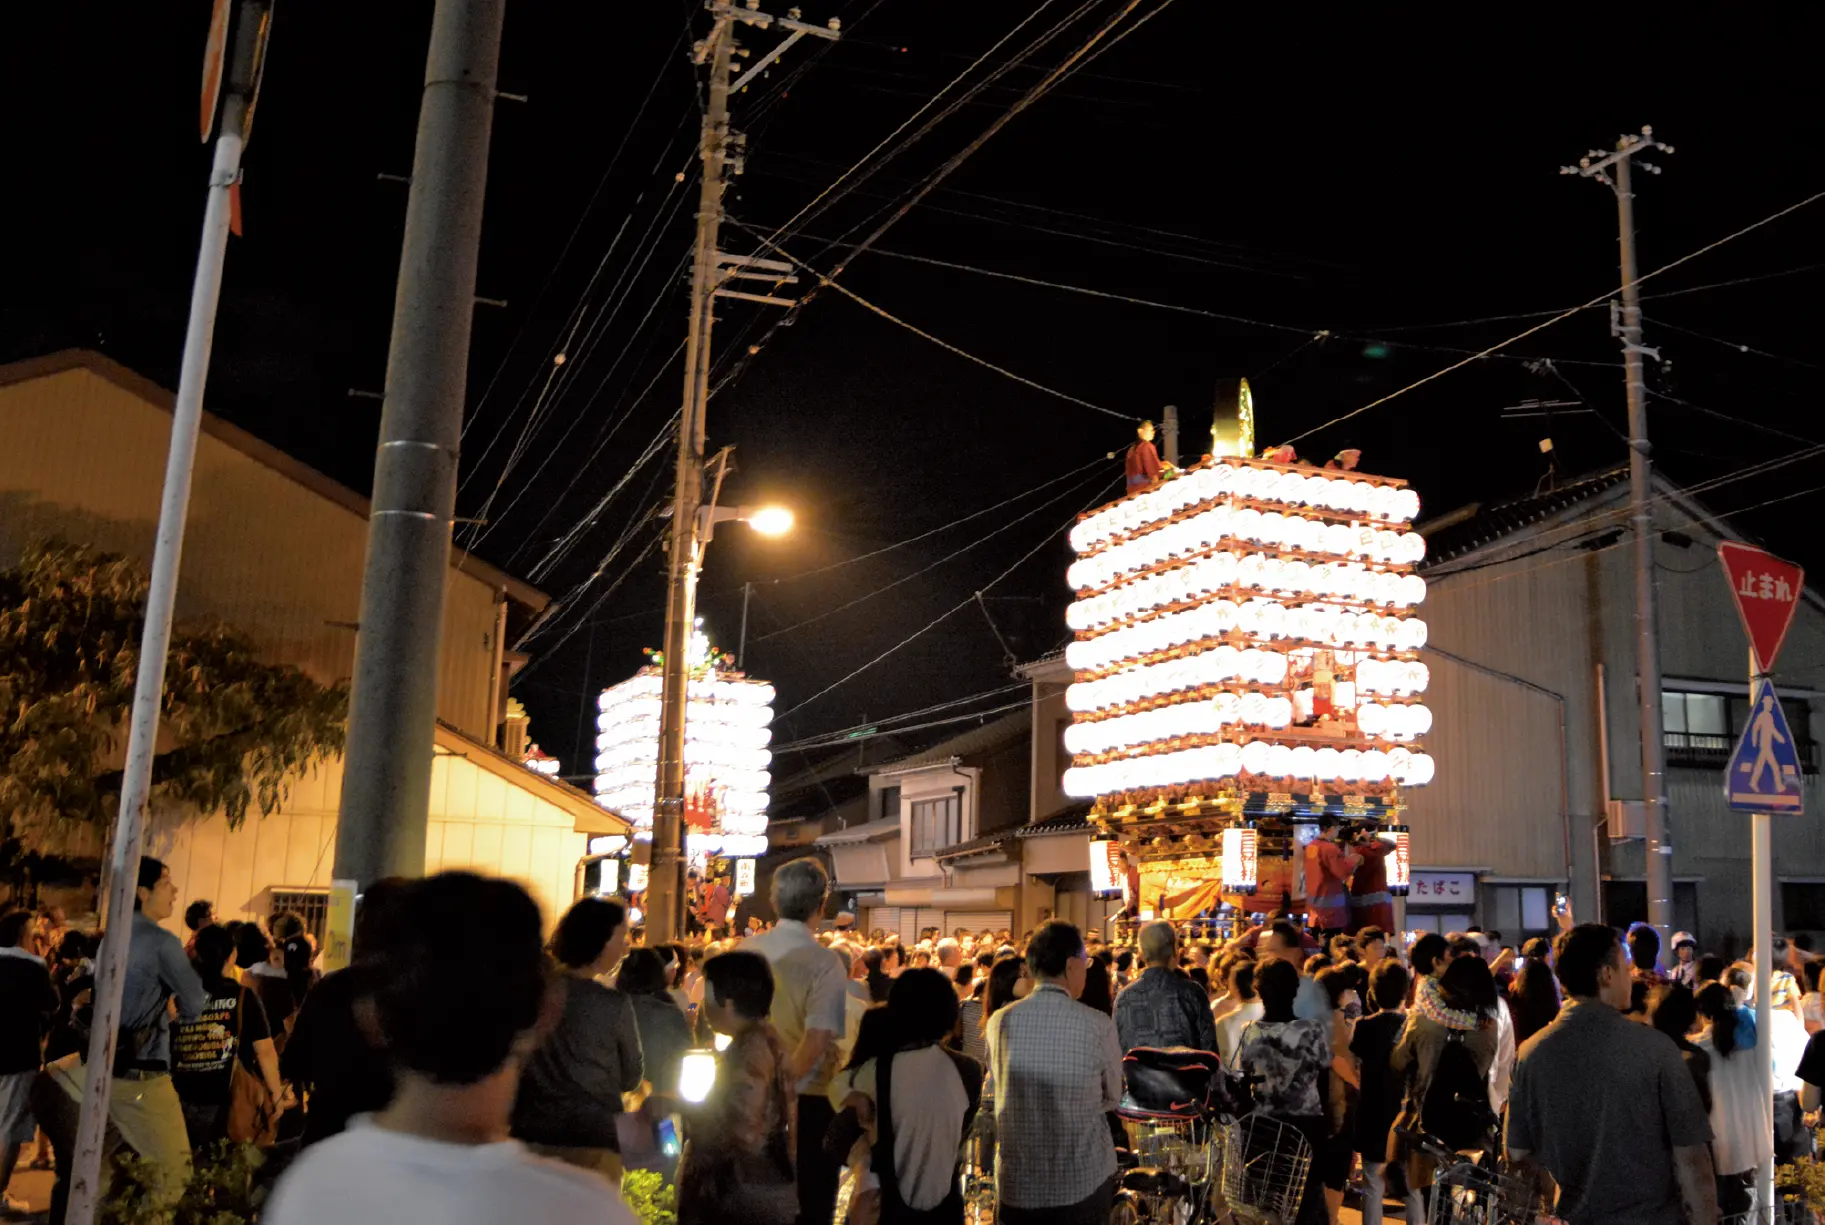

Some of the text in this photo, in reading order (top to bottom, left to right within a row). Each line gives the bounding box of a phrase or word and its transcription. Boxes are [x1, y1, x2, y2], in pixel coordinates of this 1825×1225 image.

[1739, 570, 1792, 602] 止まれ
[1416, 879, 1460, 895] たばこ
